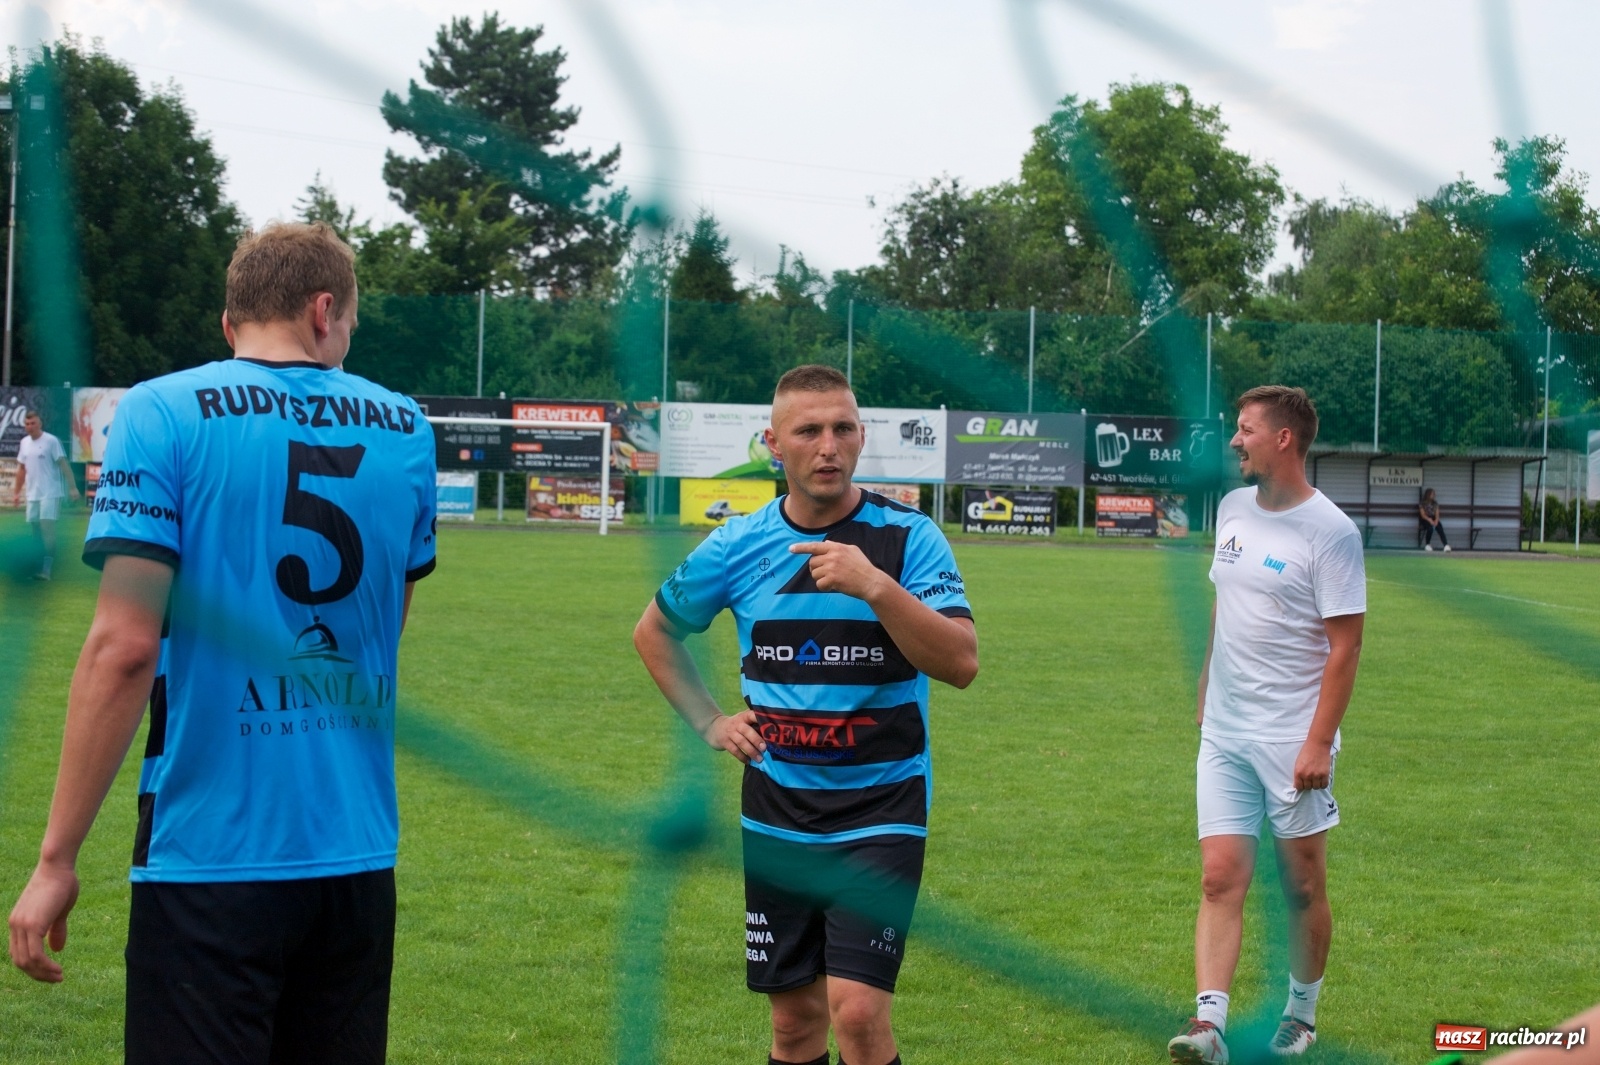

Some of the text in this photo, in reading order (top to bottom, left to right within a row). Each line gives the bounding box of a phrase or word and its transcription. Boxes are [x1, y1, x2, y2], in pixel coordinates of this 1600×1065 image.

[195, 384, 415, 435] RUDYSZWAŁD
[517, 408, 601, 422] KREWETKA
[966, 416, 1039, 436] GRAN
[1133, 427, 1163, 442] LEX
[1149, 447, 1182, 462] BAR
[1090, 472, 1117, 482] 47-451
[1098, 496, 1151, 507] KREWETKA
[276, 440, 366, 605] 5
[966, 523, 984, 533] tel.
[754, 644, 885, 662] PRO GIPS
[237, 672, 391, 713] ARNOLD
[757, 713, 878, 748] GEMAT
[870, 939, 898, 955] PEHA
